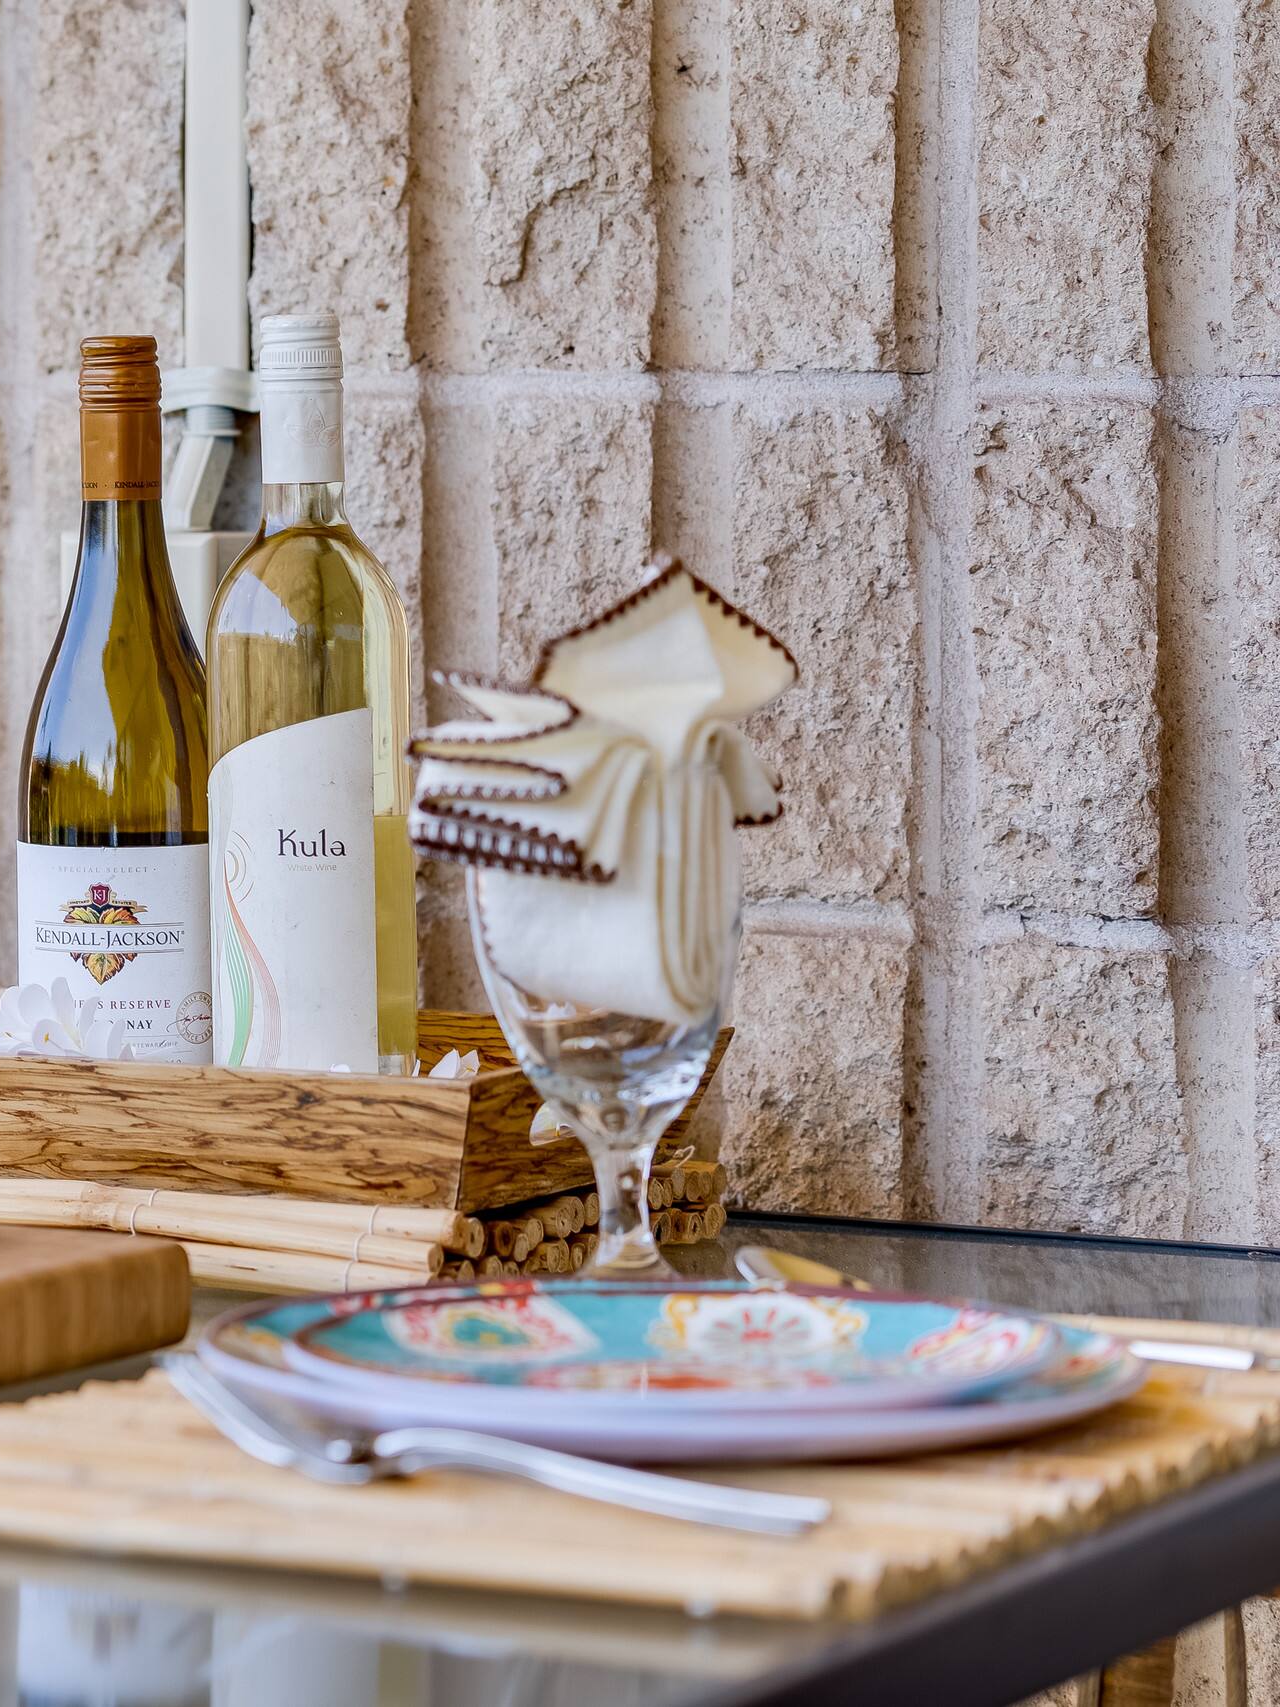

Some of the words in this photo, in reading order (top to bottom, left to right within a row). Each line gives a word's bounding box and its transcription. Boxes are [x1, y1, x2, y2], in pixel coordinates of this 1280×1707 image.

[277, 828, 347, 858] Kula
[58, 866, 101, 874] SPECIAL
[287, 864, 313, 872] White
[315, 864, 337, 872] Wine
[110, 999, 171, 1010] RESERVE
